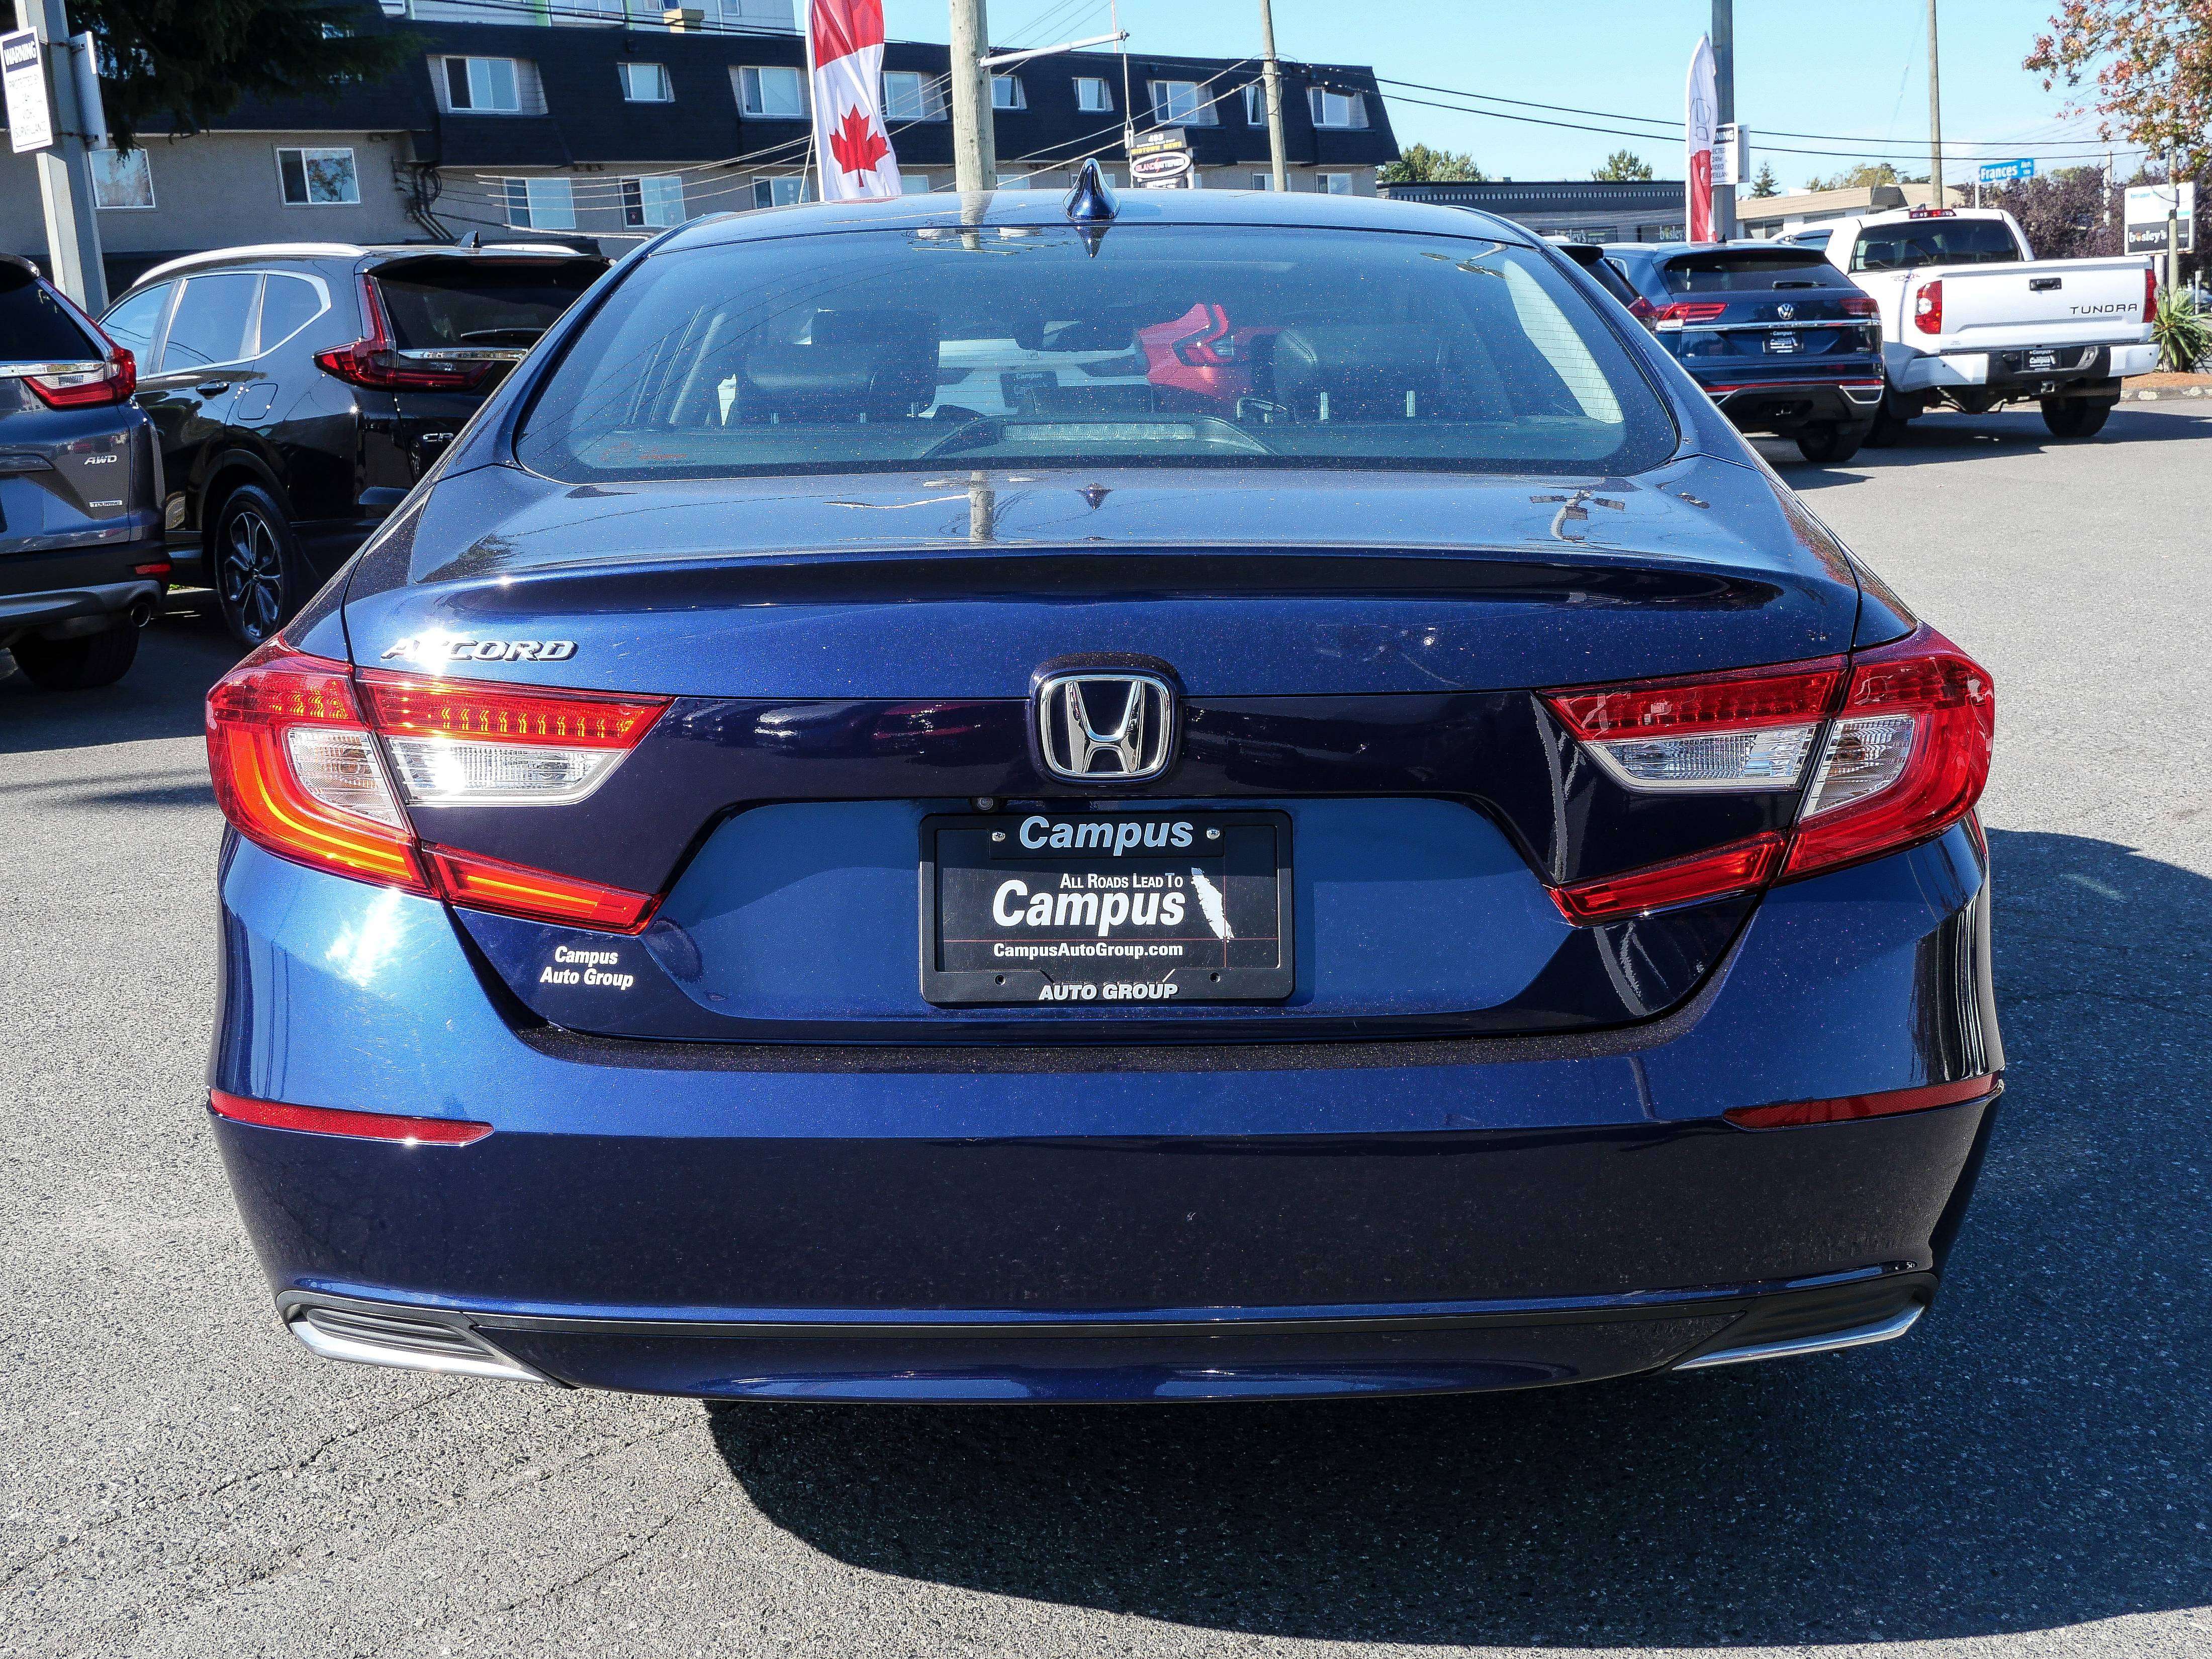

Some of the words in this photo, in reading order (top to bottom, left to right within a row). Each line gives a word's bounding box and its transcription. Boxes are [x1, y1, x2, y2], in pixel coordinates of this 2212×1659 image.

[4, 41, 37, 66] WARNING
[1716, 130, 1734, 141] NING
[1131, 145, 1160, 155] MIDTOWN
[1163, 141, 1182, 149] NEWS
[1981, 165, 2017, 179] Frances
[2070, 304, 2138, 315] TUNDRA
[83, 454, 117, 465] AWD
[381, 639, 579, 662] ACORD
[1020, 815, 1193, 856] Campus
[992, 879, 1185, 937] Campus
[555, 946, 618, 967] Campus
[994, 943, 1183, 959] CampusAutoGroup.com
[540, 966, 580, 984] Auto
[584, 968, 633, 990] Group
[1039, 984, 1097, 1000] AUTO
[1102, 984, 1178, 999] GROUP
